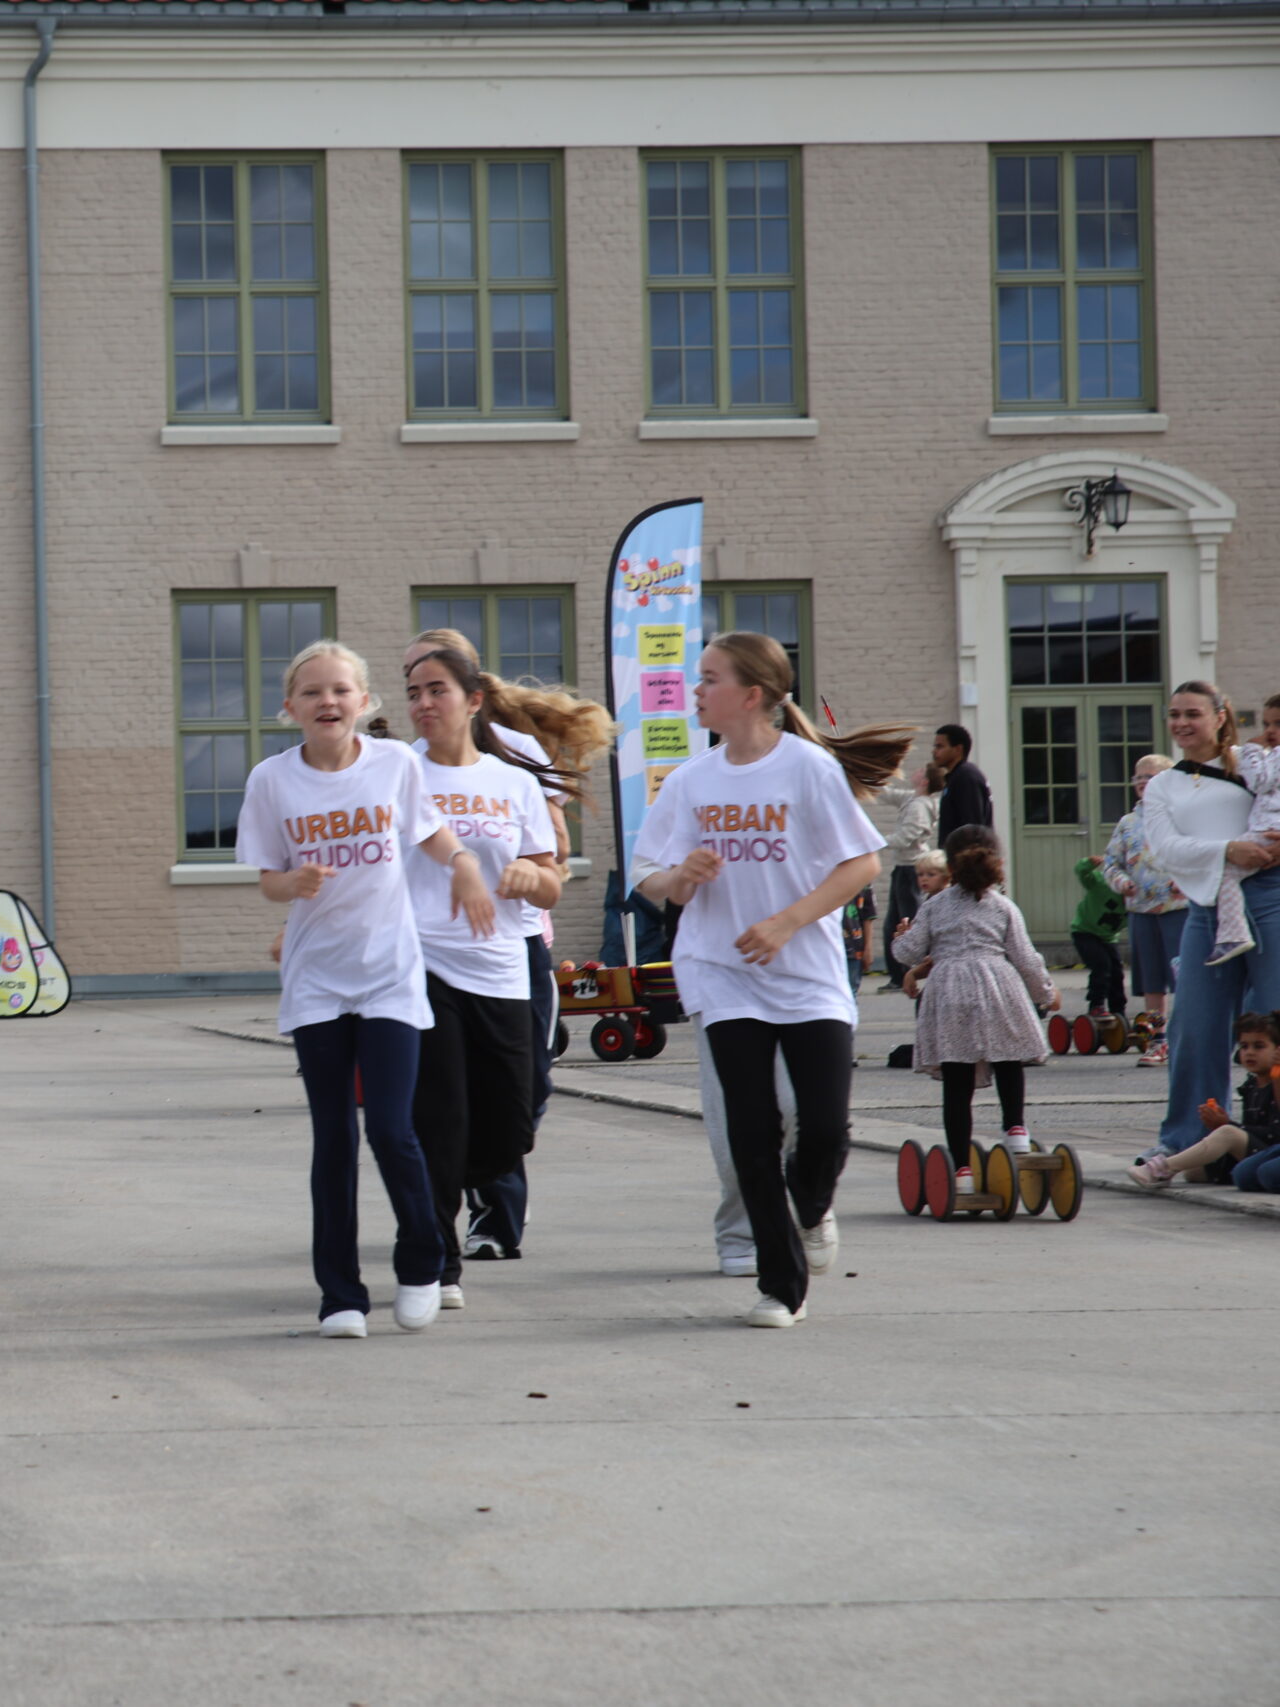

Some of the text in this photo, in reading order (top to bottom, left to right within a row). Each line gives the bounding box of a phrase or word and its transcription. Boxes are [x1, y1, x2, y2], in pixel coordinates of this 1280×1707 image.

[431, 793, 511, 819] RBAN
[284, 804, 392, 845] URBAN
[298, 839, 393, 868] TUDIOS
[701, 838, 787, 862] UDIOS
